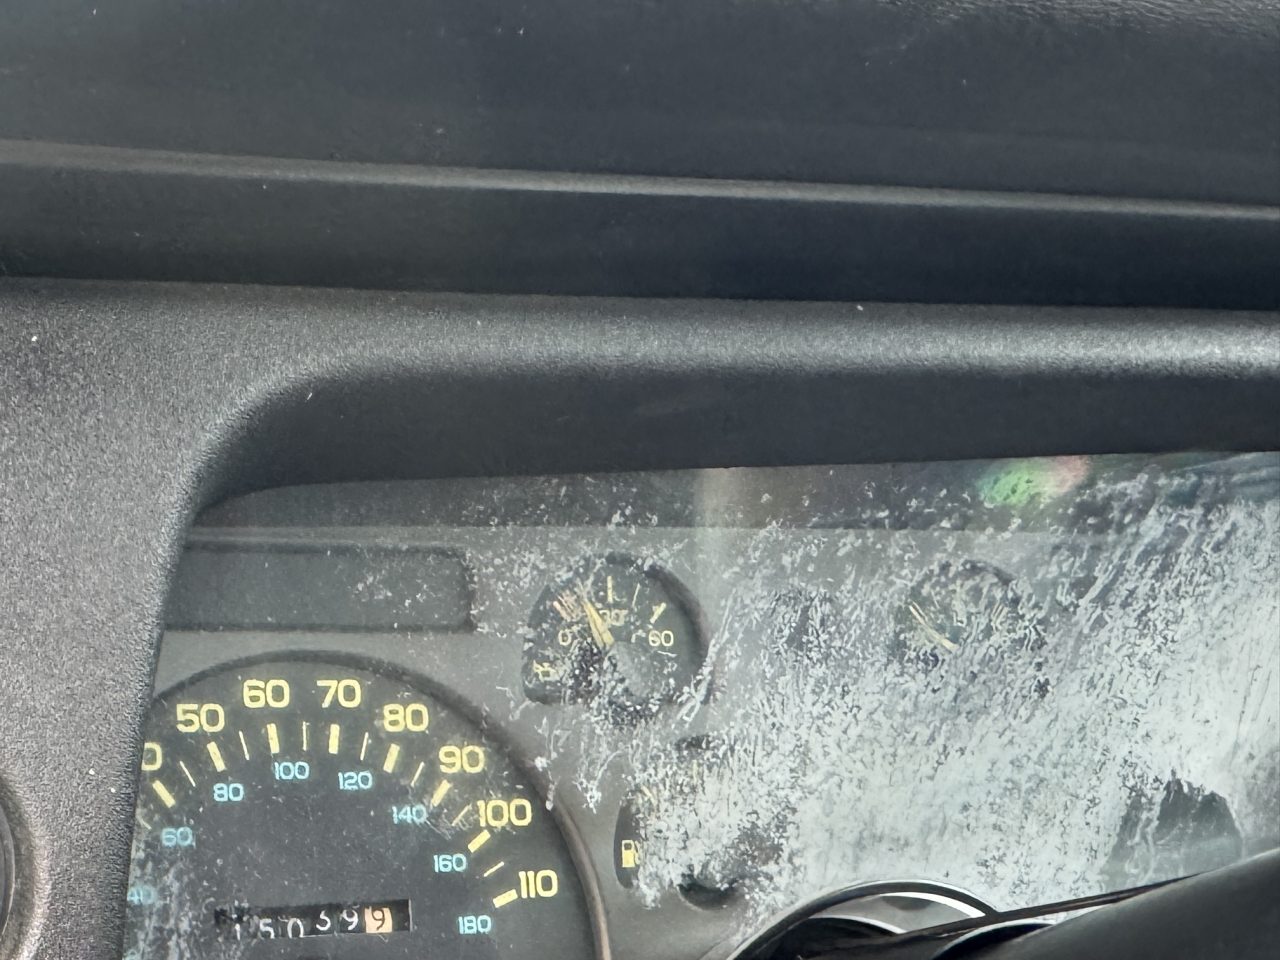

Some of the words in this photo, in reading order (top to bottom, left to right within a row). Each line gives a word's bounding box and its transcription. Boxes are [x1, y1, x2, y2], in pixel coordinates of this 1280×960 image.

[648, 630, 674, 647] 60
[243, 679, 290, 708] 60
[317, 679, 361, 708] 70
[176, 703, 225, 733] 50
[383, 703, 429, 732] 80
[438, 745, 485, 774] 90
[274, 761, 310, 780] 100
[338, 772, 373, 790] 120
[213, 783, 244, 802] 80
[392, 805, 427, 825] 140
[477, 799, 532, 827] 100
[160, 827, 194, 847] 60
[433, 854, 467, 873] 160
[518, 869, 558, 898] 110
[457, 915, 492, 934] 180
